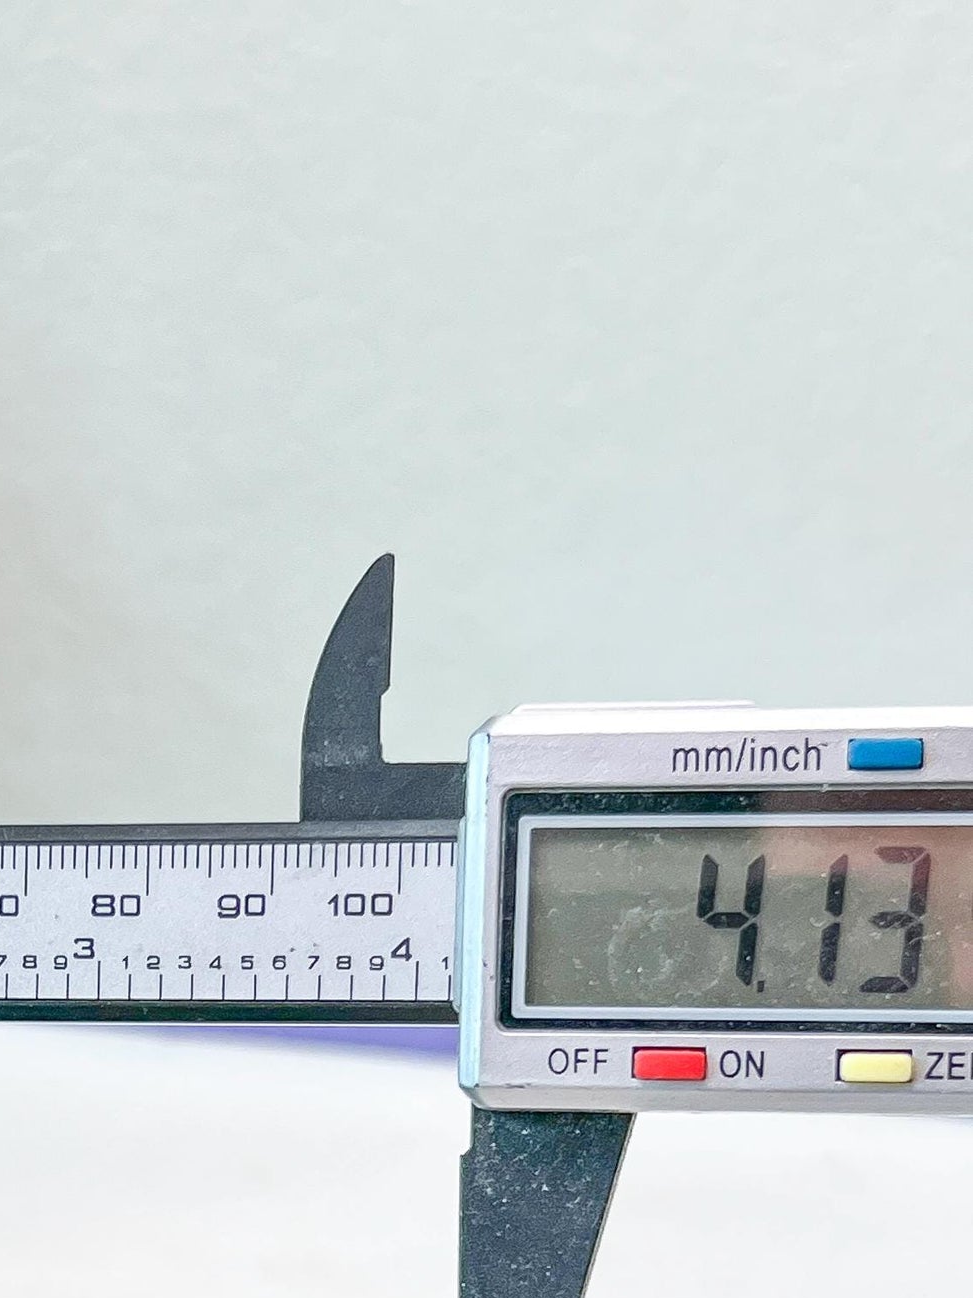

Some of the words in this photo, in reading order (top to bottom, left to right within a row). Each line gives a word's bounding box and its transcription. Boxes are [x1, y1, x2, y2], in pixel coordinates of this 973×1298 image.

[672, 737, 822, 773] mm/inch
[90, 894, 141, 918] 80
[217, 893, 266, 919] 90
[327, 893, 394, 917] 100
[696, 845, 930, 993] 4.13
[22, 954, 38, 970] 8
[53, 954, 68, 971] 9
[72, 937, 96, 960] 3
[122, 955, 129, 970] 1
[146, 955, 161, 970] 2
[177, 955, 192, 970] 3
[208, 955, 223, 970] 4
[240, 955, 255, 971] 5
[272, 954, 287, 971] 6
[307, 955, 320, 970] 7
[335, 955, 352, 970] 8
[369, 955, 385, 971] 9
[390, 937, 413, 962] 4
[441, 956, 449, 971] 1
[547, 1047, 609, 1075] OFF
[719, 1049, 765, 1079] ON
[922, 1051, 973, 1081] ZE
